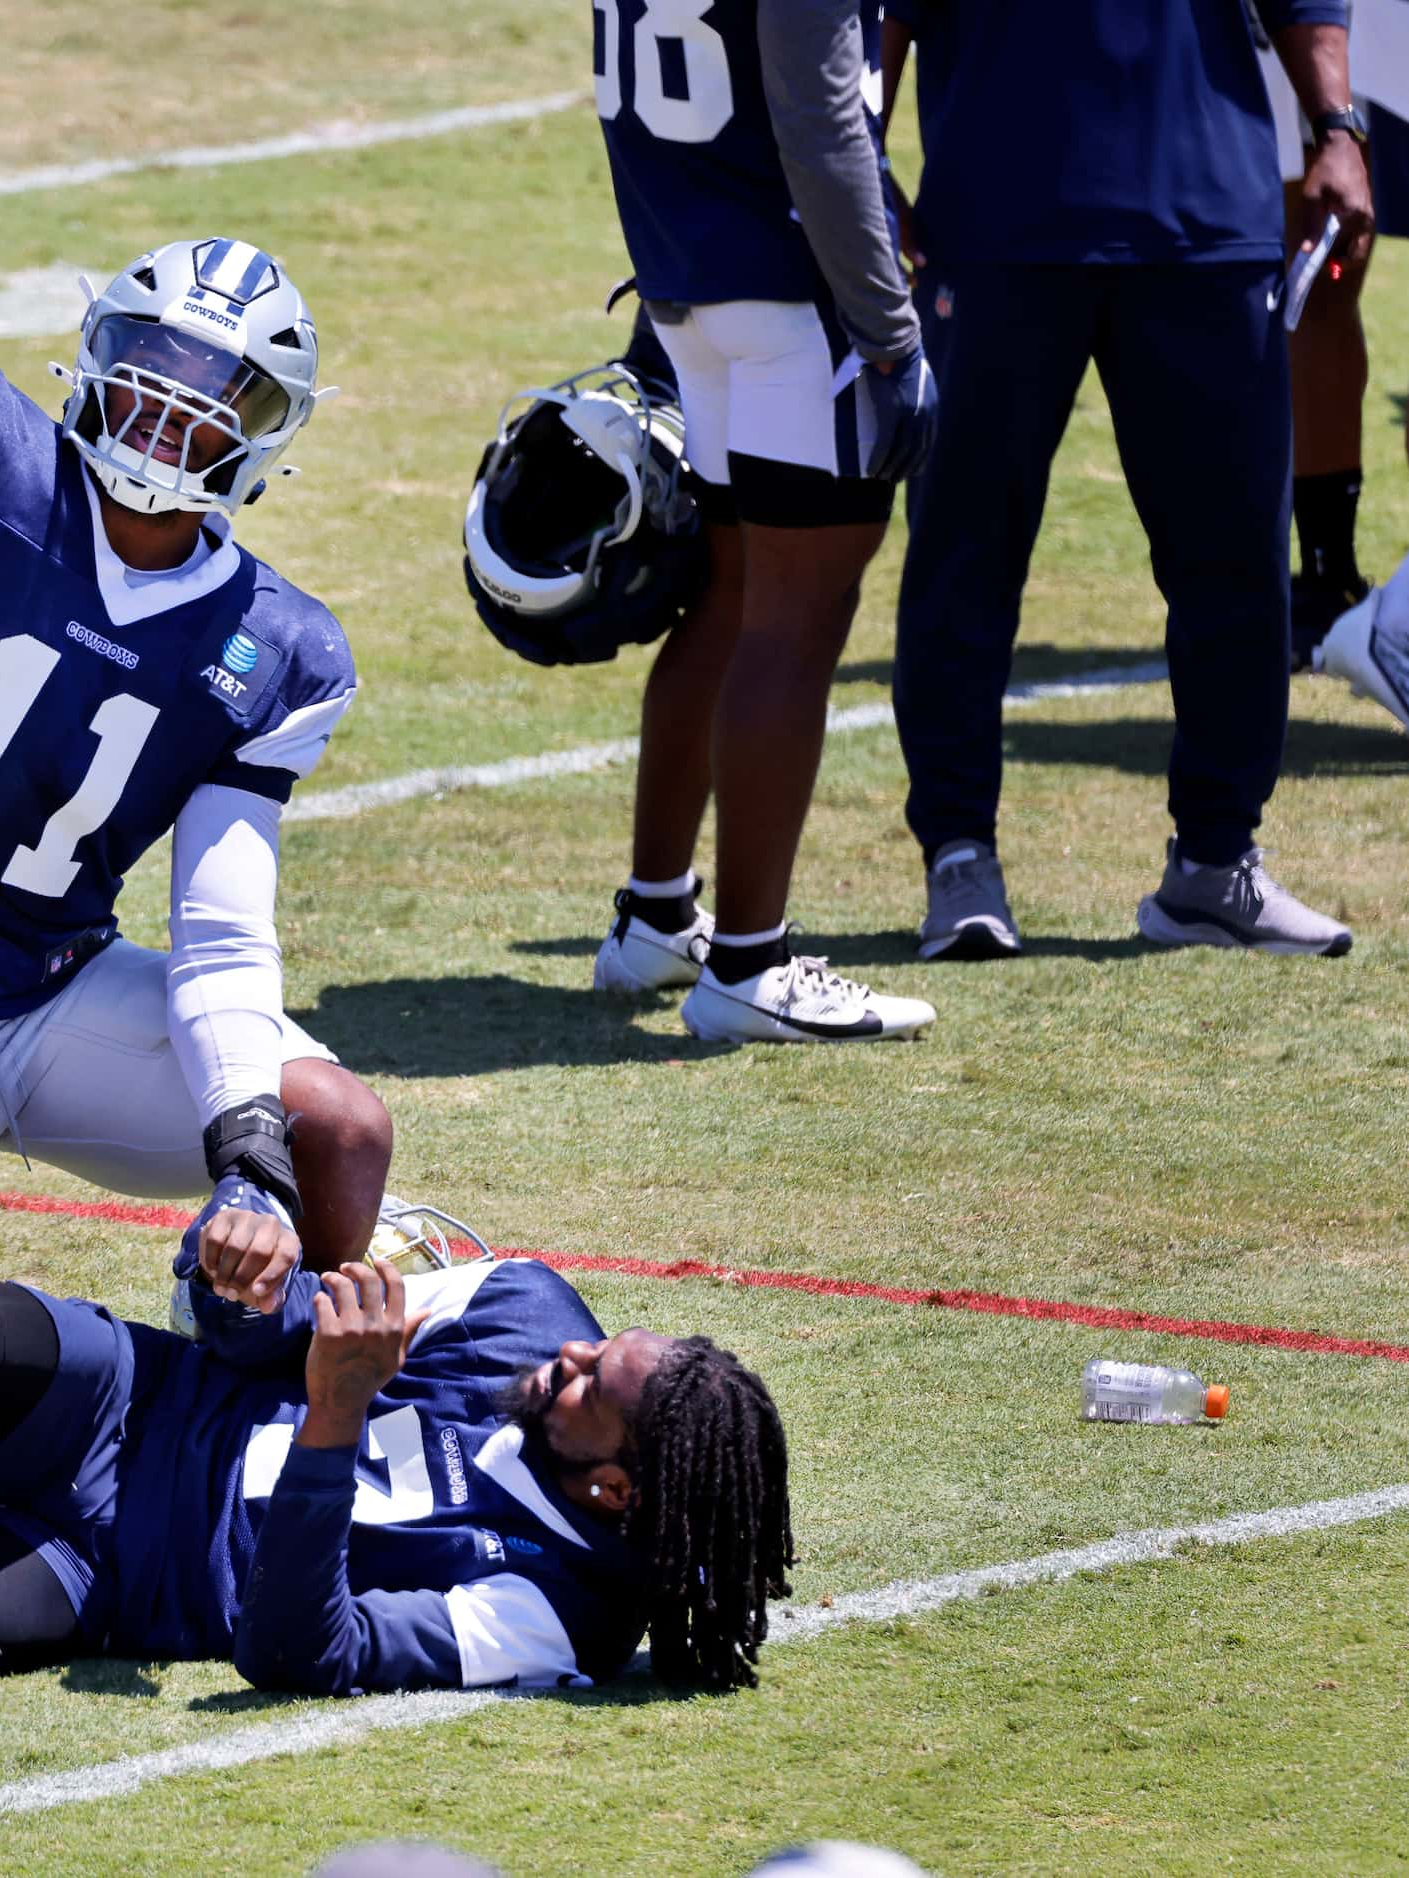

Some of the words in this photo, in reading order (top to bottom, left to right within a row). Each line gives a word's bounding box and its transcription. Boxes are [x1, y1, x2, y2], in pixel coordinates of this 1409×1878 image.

[183, 302, 239, 331] COWBOYS
[66, 620, 140, 670] COWBOYS
[200, 664, 248, 699] AT&T
[441, 1427, 469, 1505] COWBOYS
